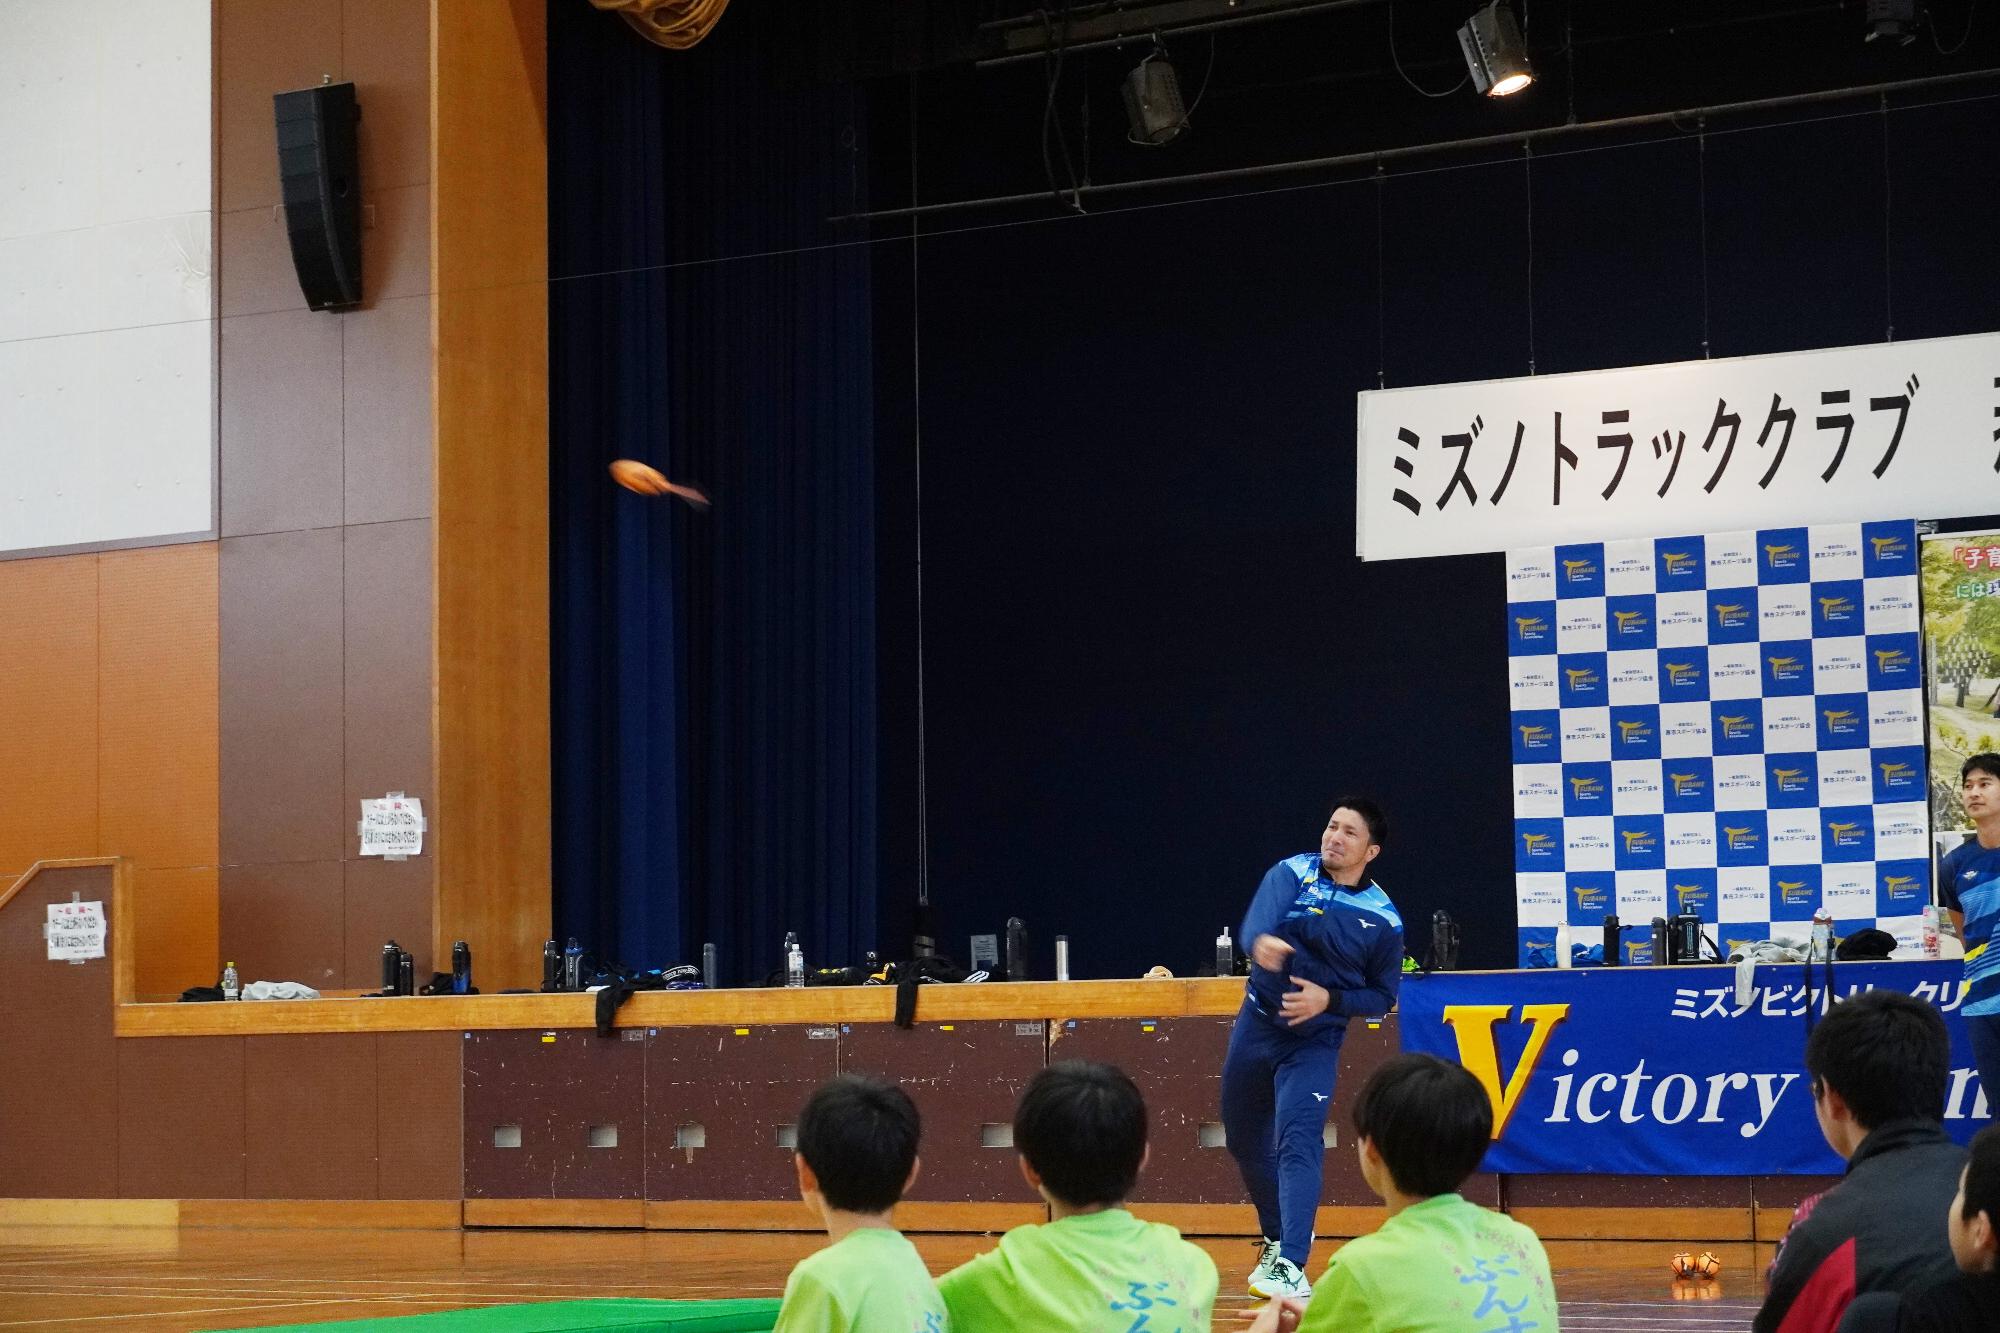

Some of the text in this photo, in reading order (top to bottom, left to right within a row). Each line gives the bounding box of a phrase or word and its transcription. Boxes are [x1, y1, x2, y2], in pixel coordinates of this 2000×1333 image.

[1392, 373, 1920, 517] ミズノトラッククラブ
[1442, 1003, 1800, 1141] Victory
